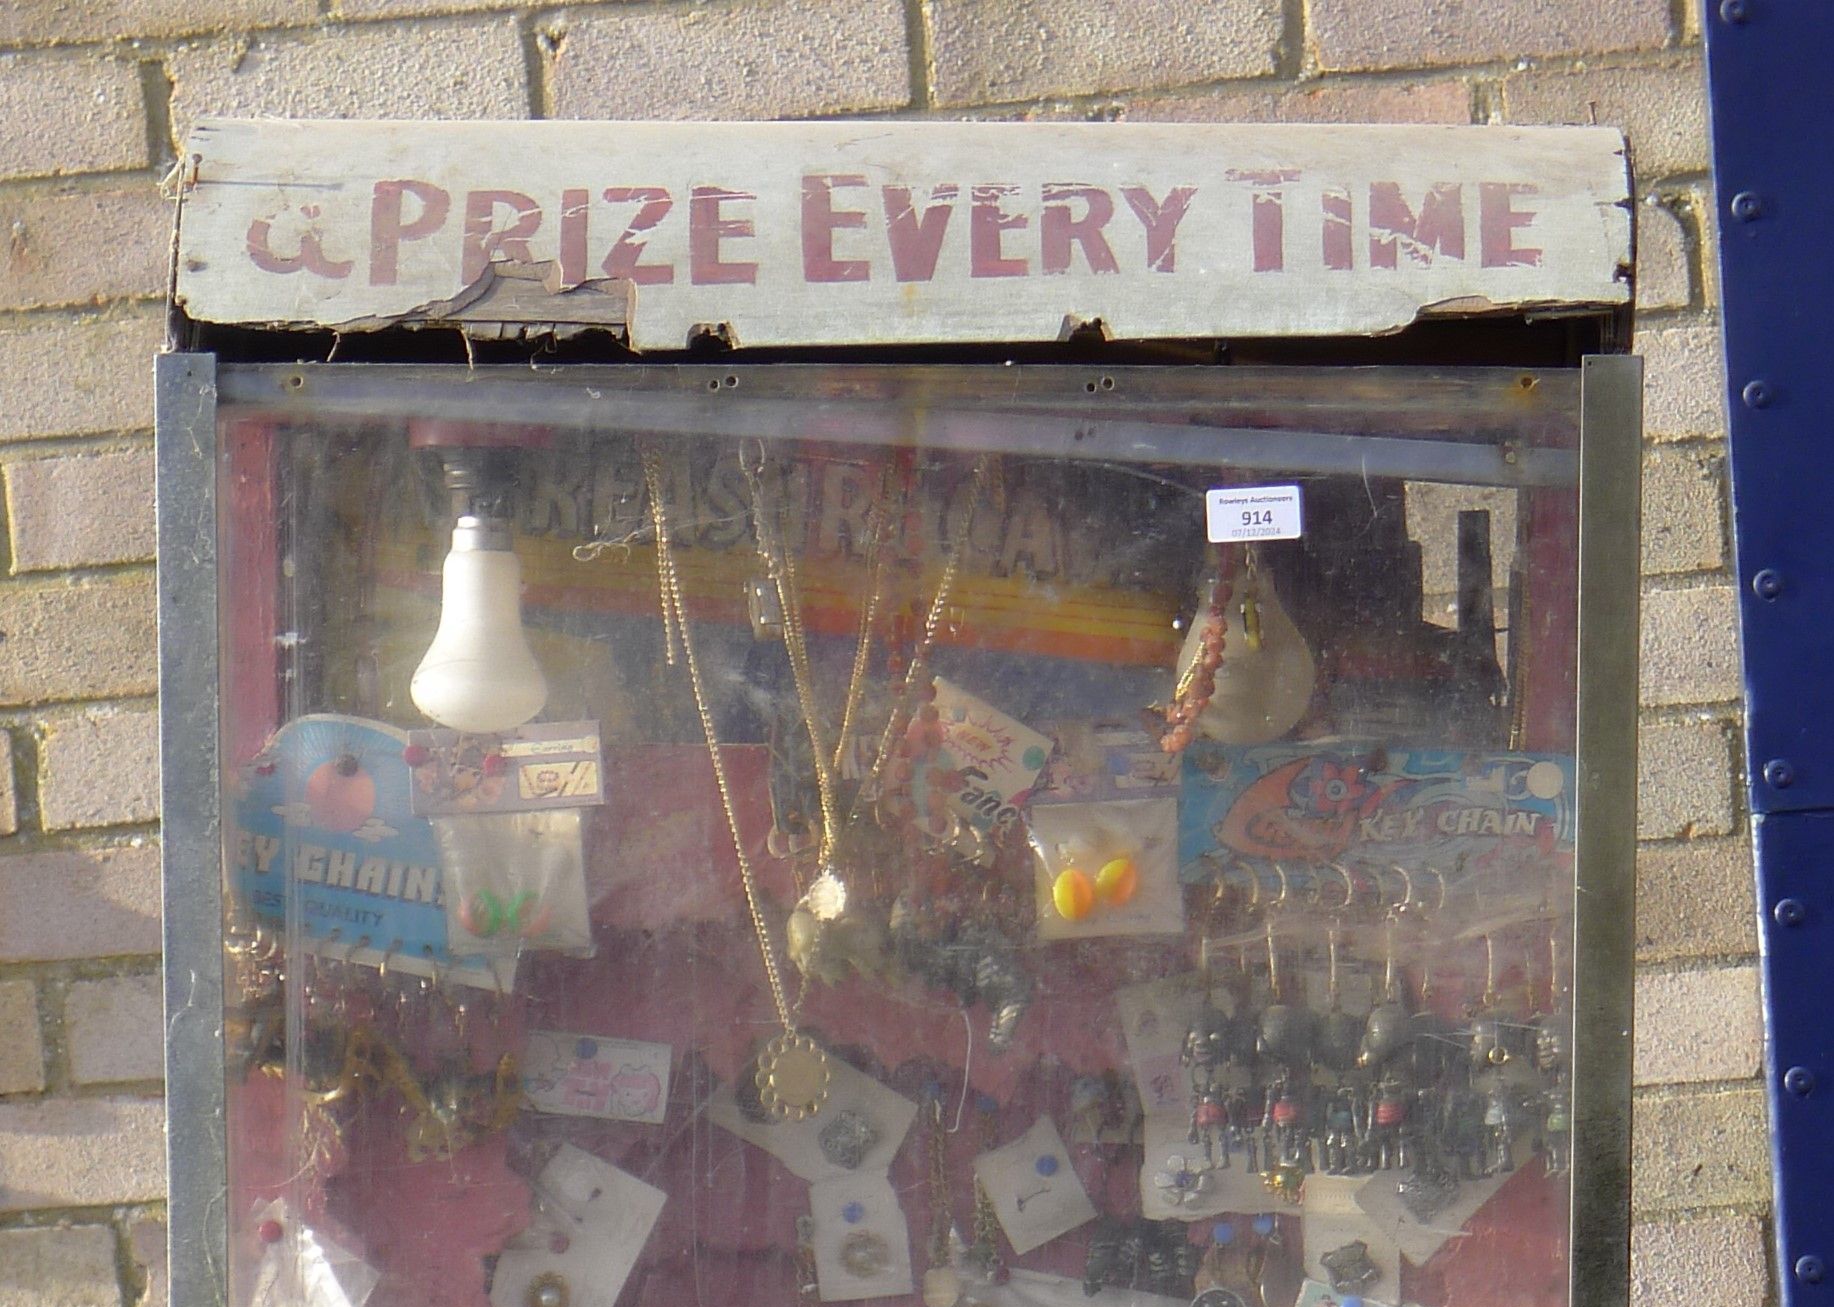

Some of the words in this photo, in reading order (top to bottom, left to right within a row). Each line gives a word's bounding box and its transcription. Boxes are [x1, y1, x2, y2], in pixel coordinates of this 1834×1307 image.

[369, 178, 757, 287] PRIZE
[800, 174, 1198, 283] EVERY
[1225, 168, 1543, 273] TIME
[1250, 495, 1293, 504] Auctioneers
[1241, 510, 1273, 526] 914
[1359, 808, 1424, 843] KEY
[1436, 807, 1543, 837] CHAIN
